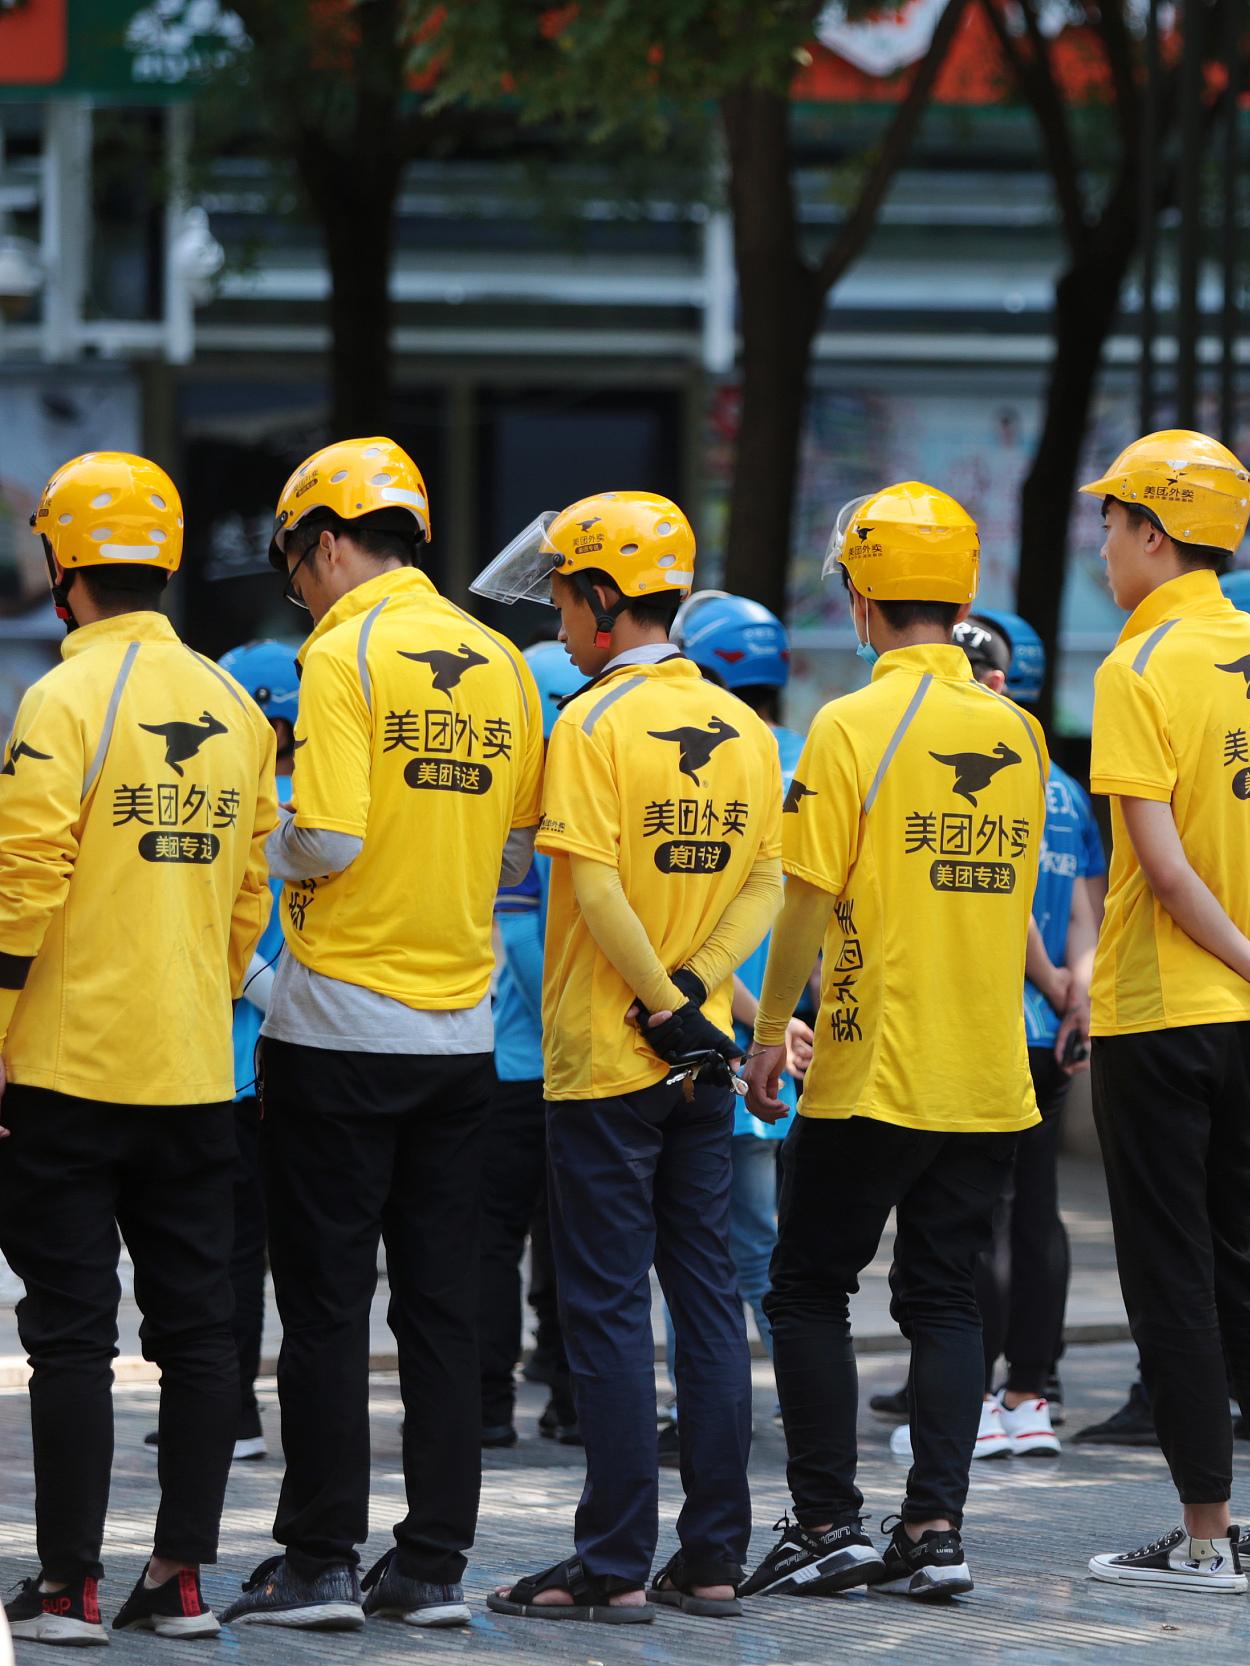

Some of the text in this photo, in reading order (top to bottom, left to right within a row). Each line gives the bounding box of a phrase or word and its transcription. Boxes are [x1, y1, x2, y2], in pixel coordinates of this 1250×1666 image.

[1143, 485, 1194, 500] 美团外卖
[382, 709, 512, 762] 美团外卖
[112, 783, 240, 829] 美团外卖
[643, 799, 749, 838] 美团外卖
[905, 811, 1030, 860] 美团外卖
[936, 864, 1011, 889] 美团专送
